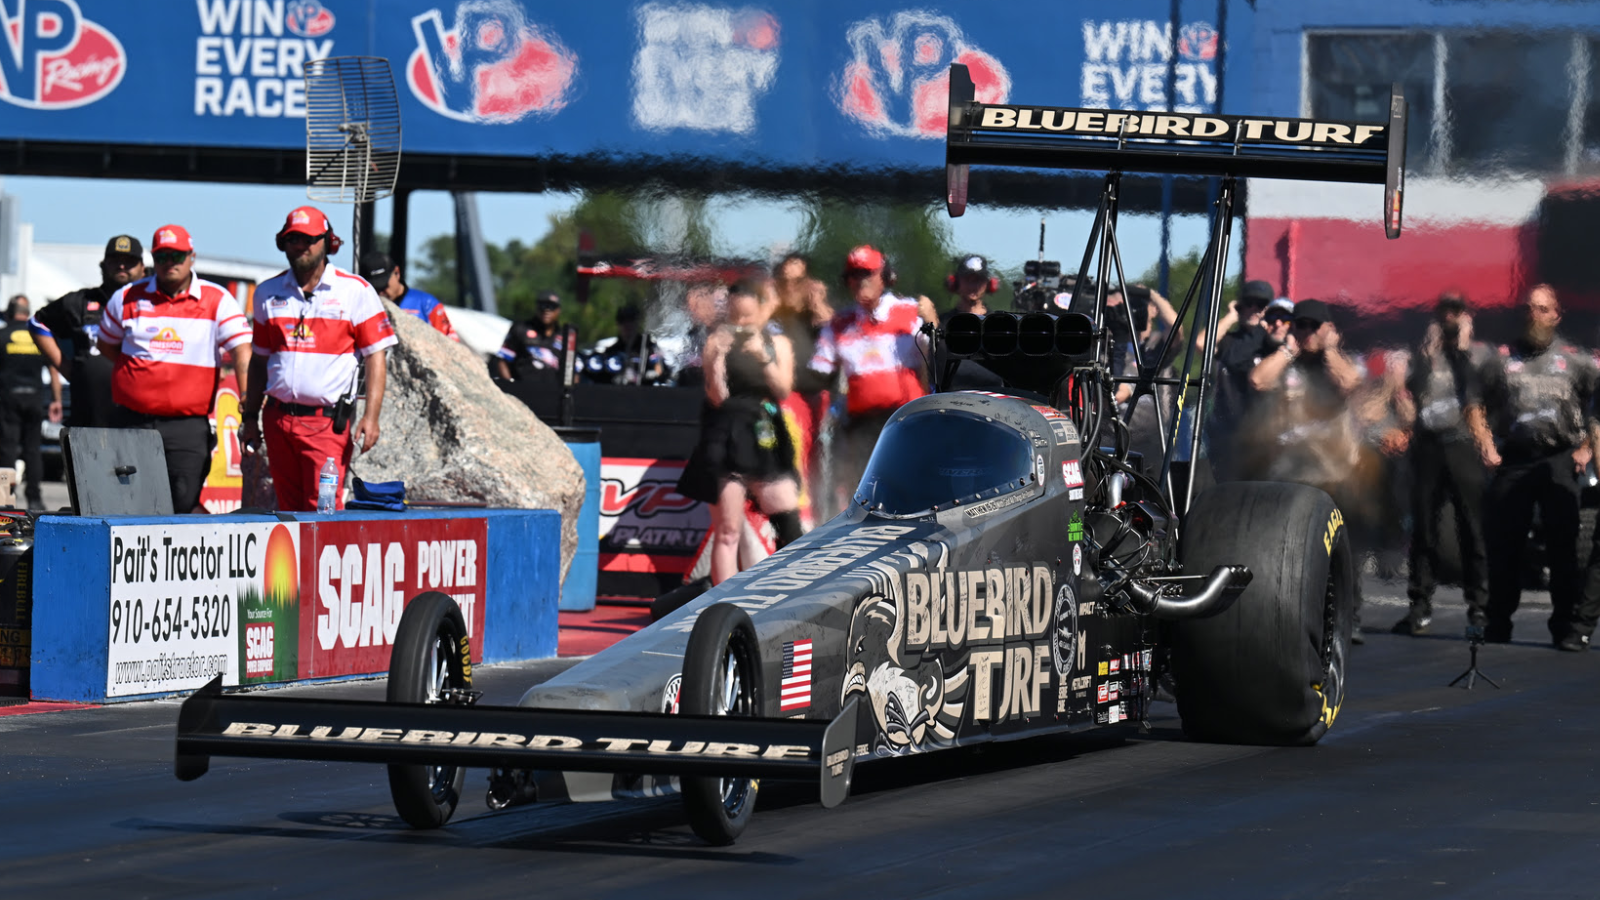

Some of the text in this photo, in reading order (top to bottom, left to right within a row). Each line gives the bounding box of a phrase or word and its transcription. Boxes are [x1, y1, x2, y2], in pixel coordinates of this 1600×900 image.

[196, 0, 284, 36] WIN
[196, 36, 334, 78] EVERY
[1083, 21, 1172, 61] WIN
[195, 77, 307, 118] RACE
[981, 107, 1384, 144] BLUEBIRD TURF
[112, 533, 257, 584] Pait's Tractor LLC
[317, 542, 405, 650] SCAG
[417, 540, 477, 588] POWER
[907, 566, 1053, 645] BLUEBIRD
[112, 594, 231, 644] 910-654-5320
[246, 626, 274, 659] SCAG
[115, 651, 228, 688] www.paitstractor.com
[969, 645, 1050, 720] TURF
[222, 722, 812, 758] BLUEBIRD TURF
